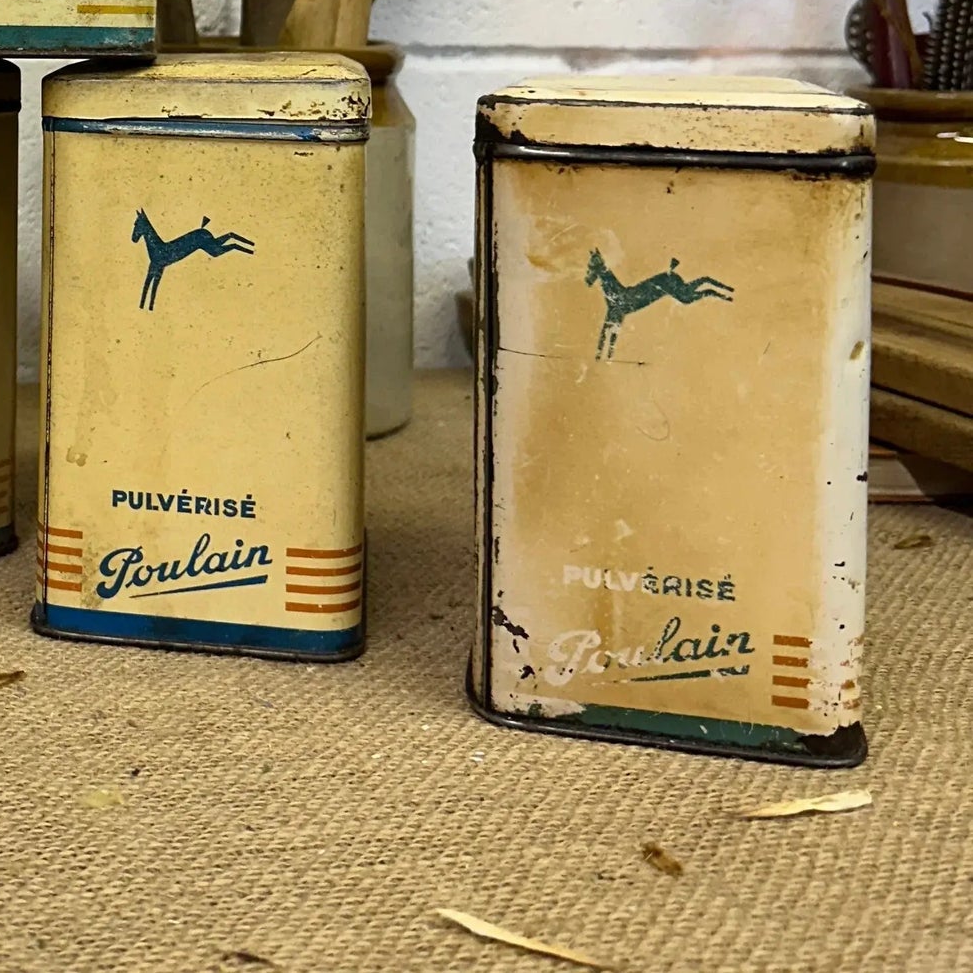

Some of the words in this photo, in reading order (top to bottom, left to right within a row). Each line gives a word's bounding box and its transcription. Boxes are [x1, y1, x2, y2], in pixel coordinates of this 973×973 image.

[111, 488, 257, 519] PULVÉRISÉ
[96, 532, 273, 600] Poulain
[562, 565, 736, 602] PULVÉRISÉ
[544, 615, 756, 687] Poulain
